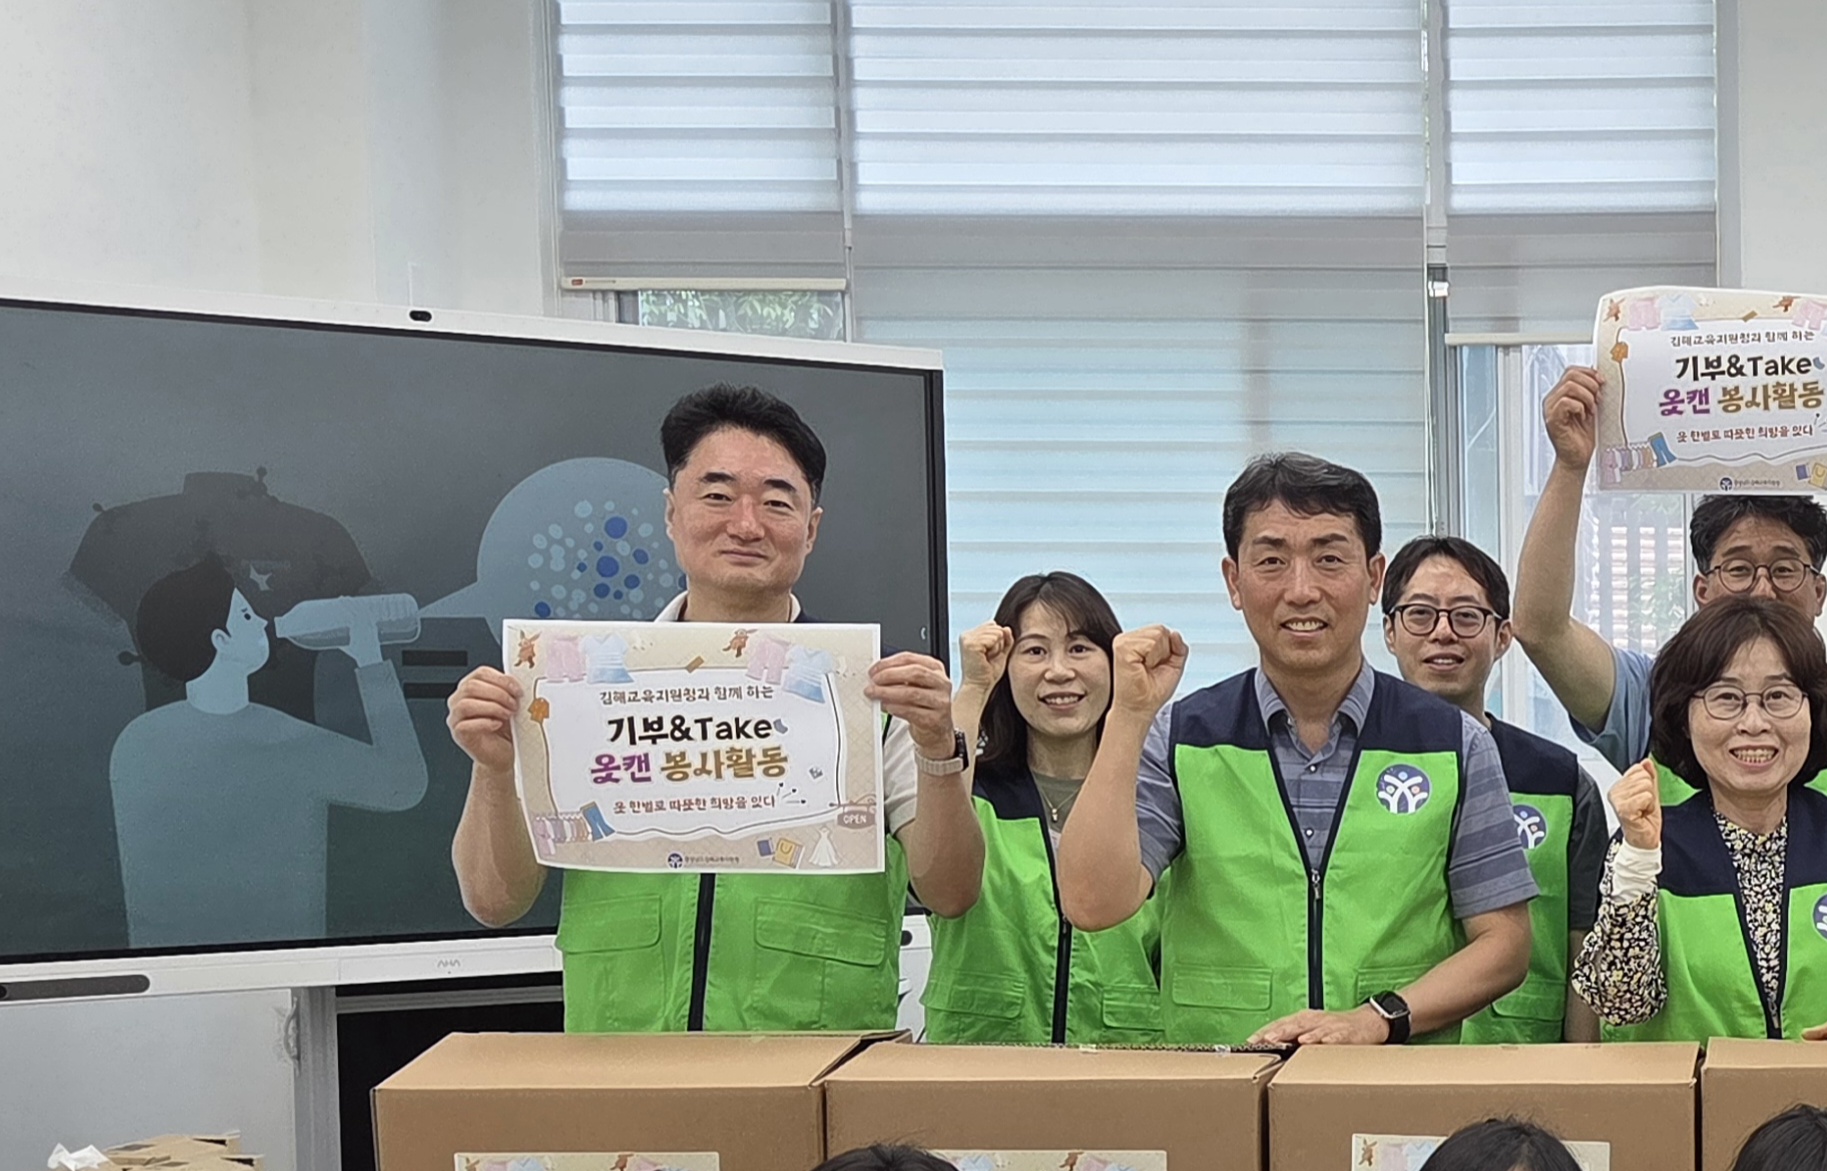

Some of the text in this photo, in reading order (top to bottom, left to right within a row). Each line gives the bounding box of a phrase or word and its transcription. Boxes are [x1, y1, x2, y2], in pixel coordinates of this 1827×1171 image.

[1676, 354, 1812, 381] 기부&Take
[1659, 380, 1824, 416] 옷캔 봉사활동
[600, 685, 774, 705] 김해교육지원청과 함께 하는
[608, 715, 772, 745] 기부&Take
[591, 745, 788, 784] 옷캔 봉사활동
[843, 813, 867, 825] OPEN
